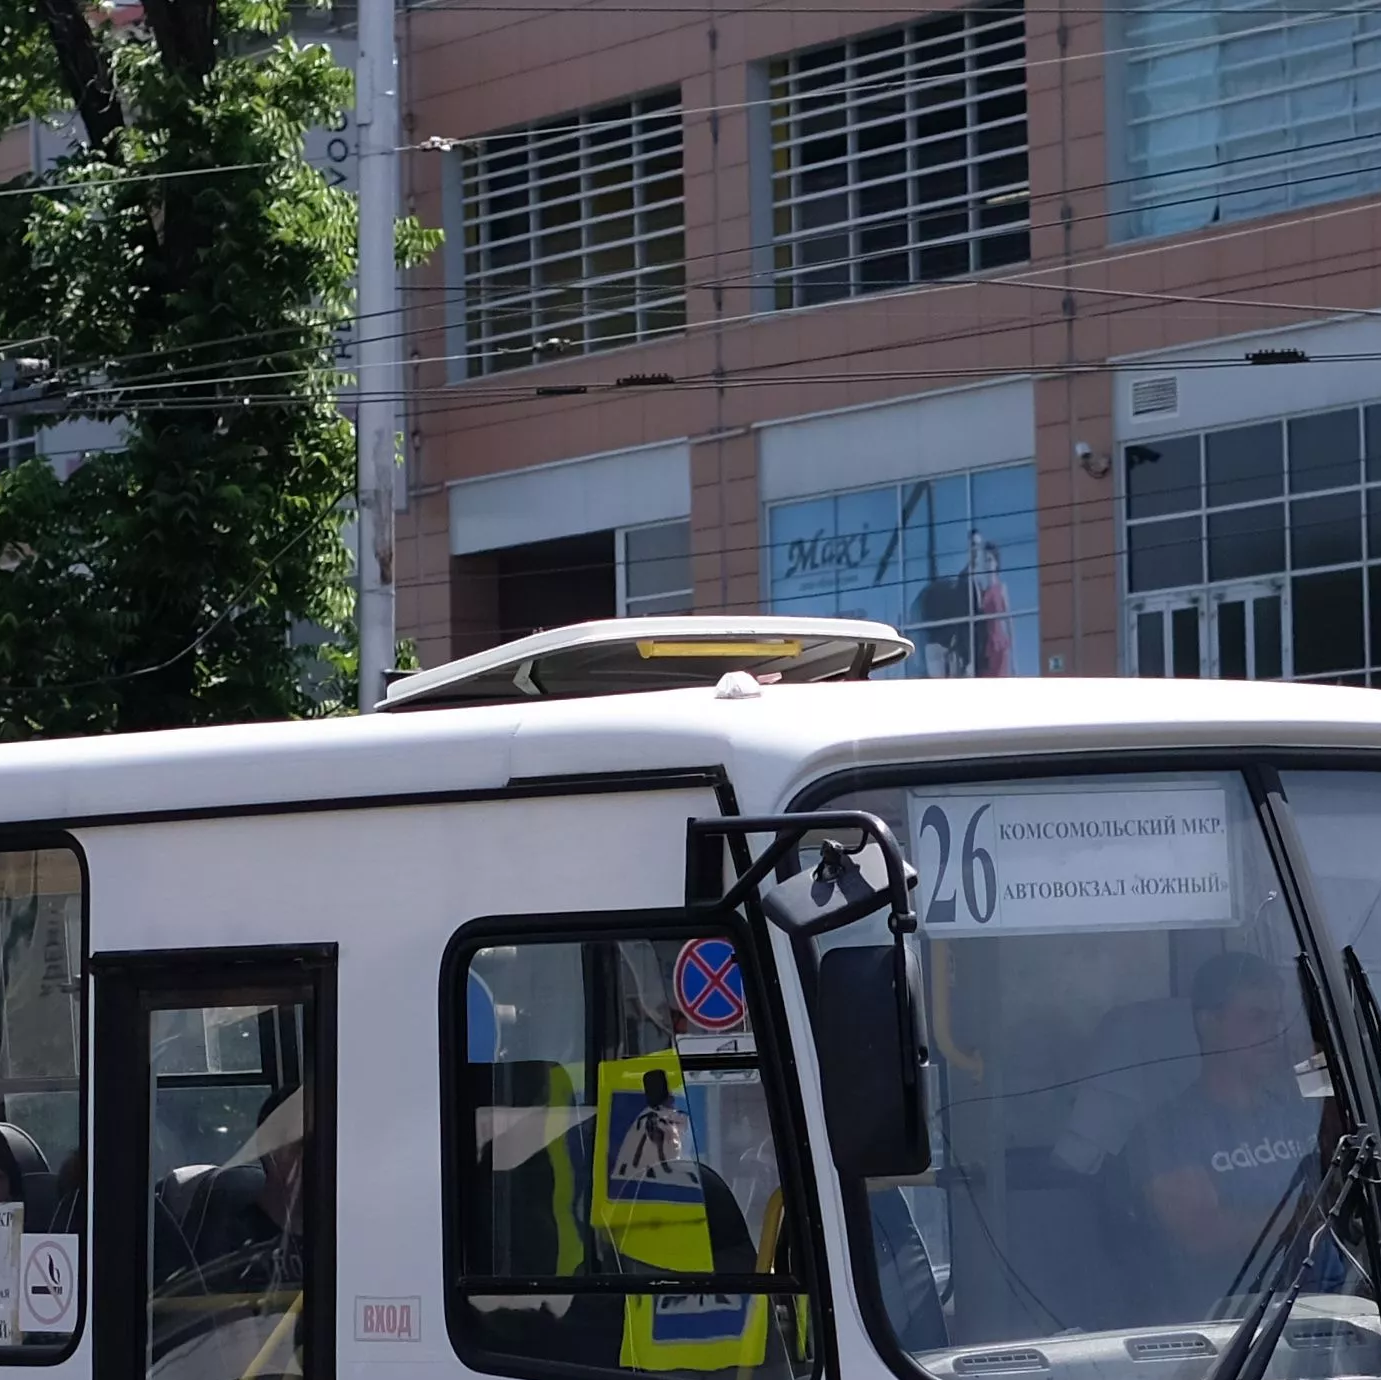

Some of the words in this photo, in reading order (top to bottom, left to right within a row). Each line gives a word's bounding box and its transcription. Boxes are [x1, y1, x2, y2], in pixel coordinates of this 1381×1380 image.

[785, 522, 870, 578] Maxi
[999, 815, 1176, 841] КОМСОМОЛЬСКИЙ
[919, 804, 997, 923] 26
[1003, 879, 1126, 901] АВТОВОКЗАЛ
[1131, 871, 1228, 896] «ЮЖНЫЙ»
[364, 1305, 411, 1337] ВХОД
